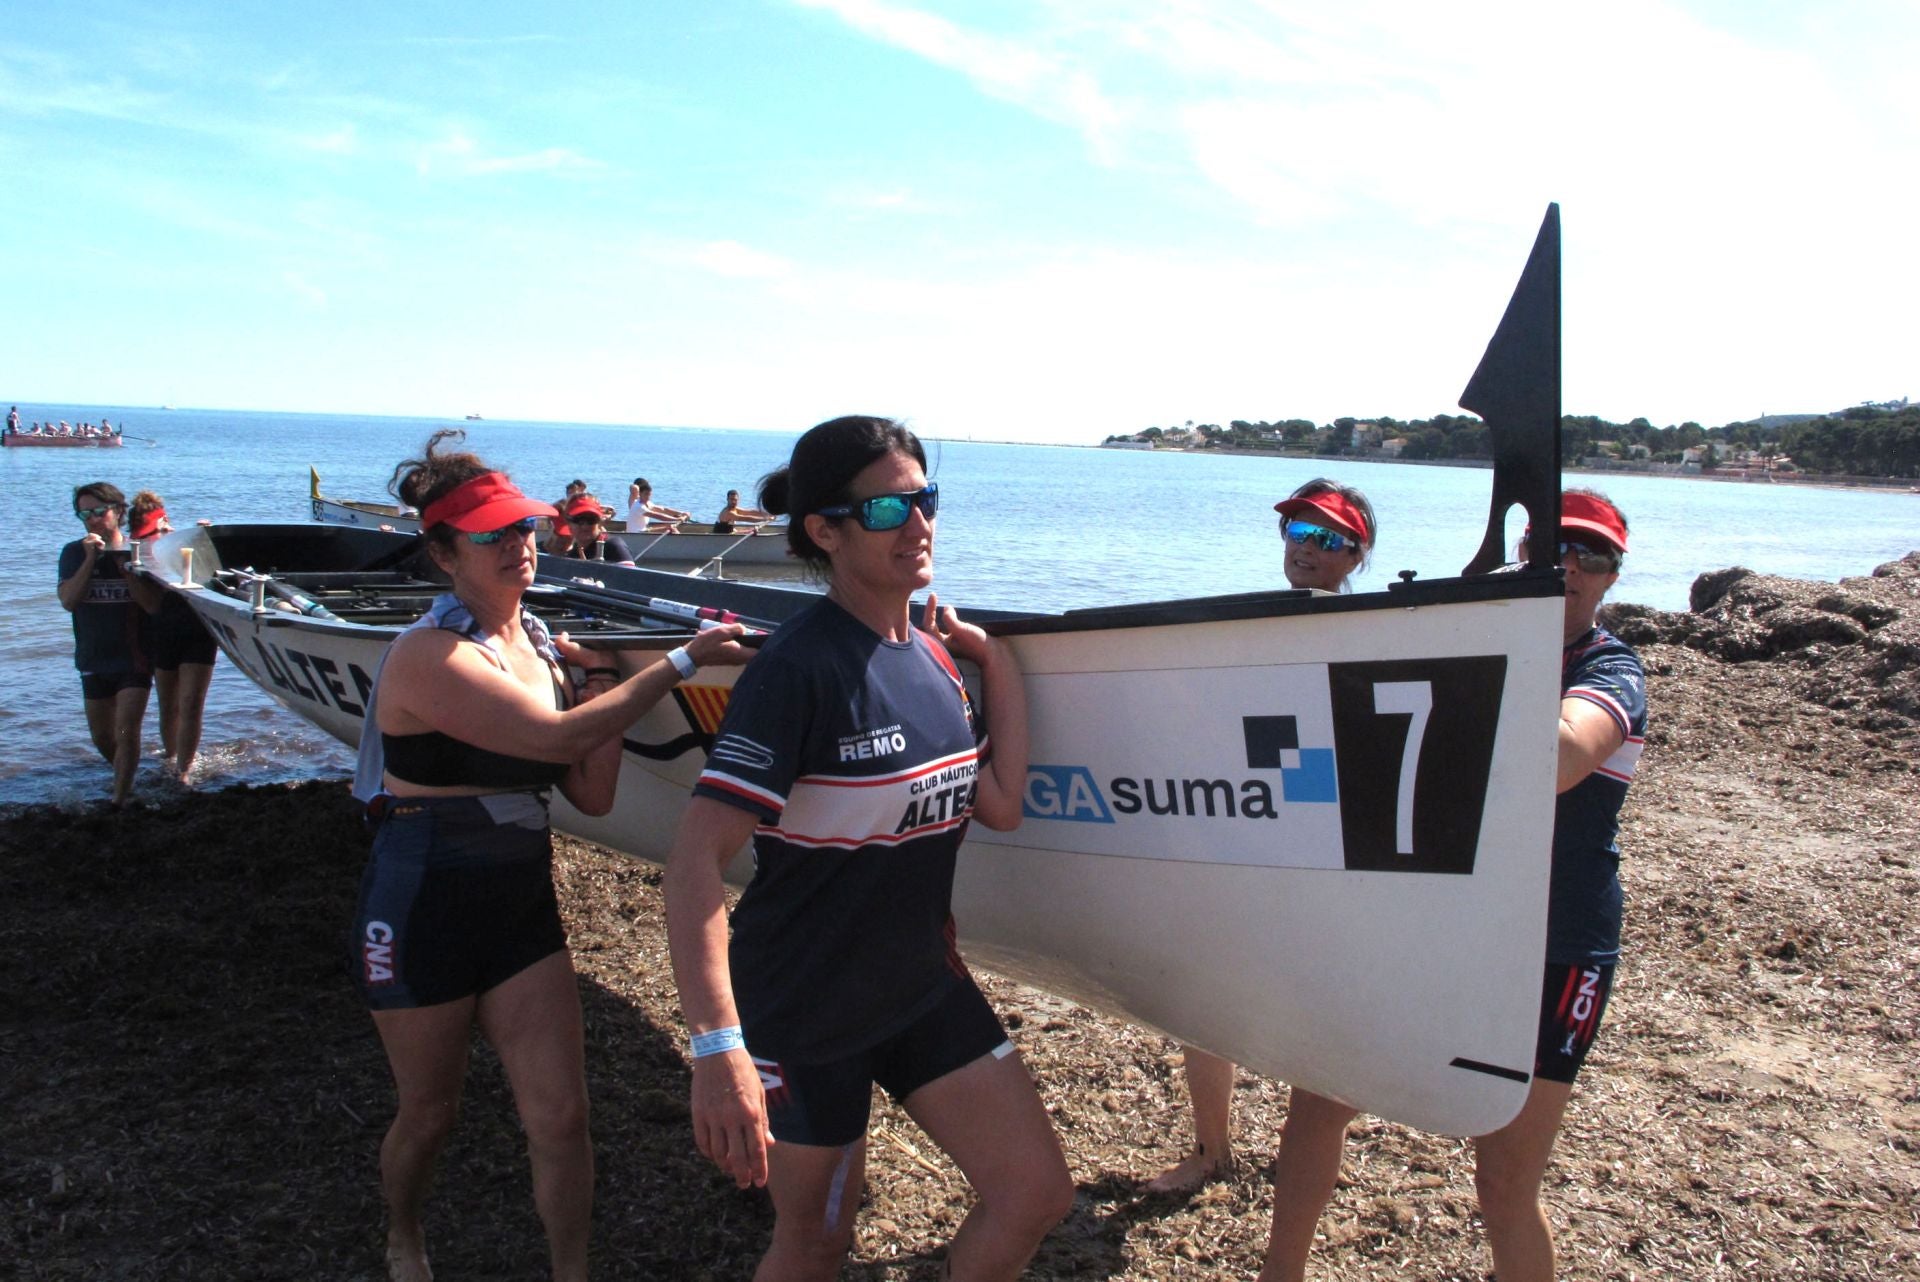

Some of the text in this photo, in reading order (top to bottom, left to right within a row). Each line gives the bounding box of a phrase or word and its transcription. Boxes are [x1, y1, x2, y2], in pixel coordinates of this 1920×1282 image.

[839, 733, 906, 762] REMO
[1373, 678, 1433, 854] 7
[910, 776, 938, 795] CLUB
[1109, 777, 1278, 819] suma
[366, 921, 393, 982] CNA
[1572, 965, 1600, 1020] CN
